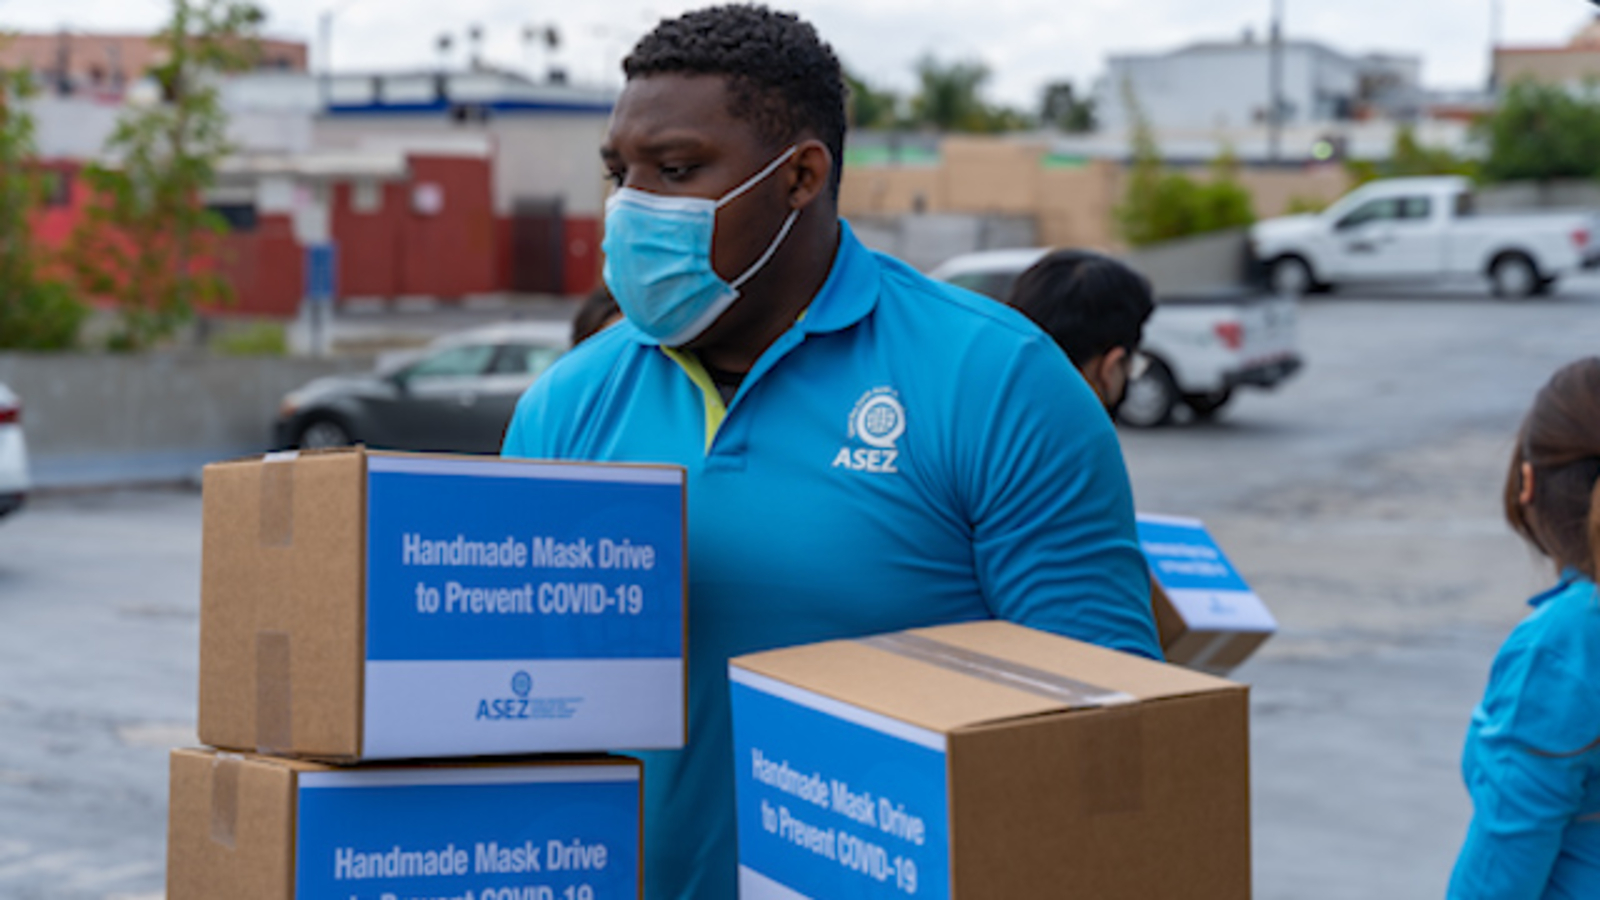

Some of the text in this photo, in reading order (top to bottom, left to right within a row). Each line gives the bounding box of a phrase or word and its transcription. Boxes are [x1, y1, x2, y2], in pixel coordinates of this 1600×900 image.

[831, 447, 898, 473] ASEZ
[402, 533, 655, 570] Handmade Mask Drive
[415, 581, 643, 615] to Prevent COVID-19
[475, 698, 530, 720] ASEZ
[751, 747, 926, 846] Handmade Mask Drive
[334, 837, 608, 880] Handmade Mask Drive
[761, 799, 918, 895] to Prevent COVID-19
